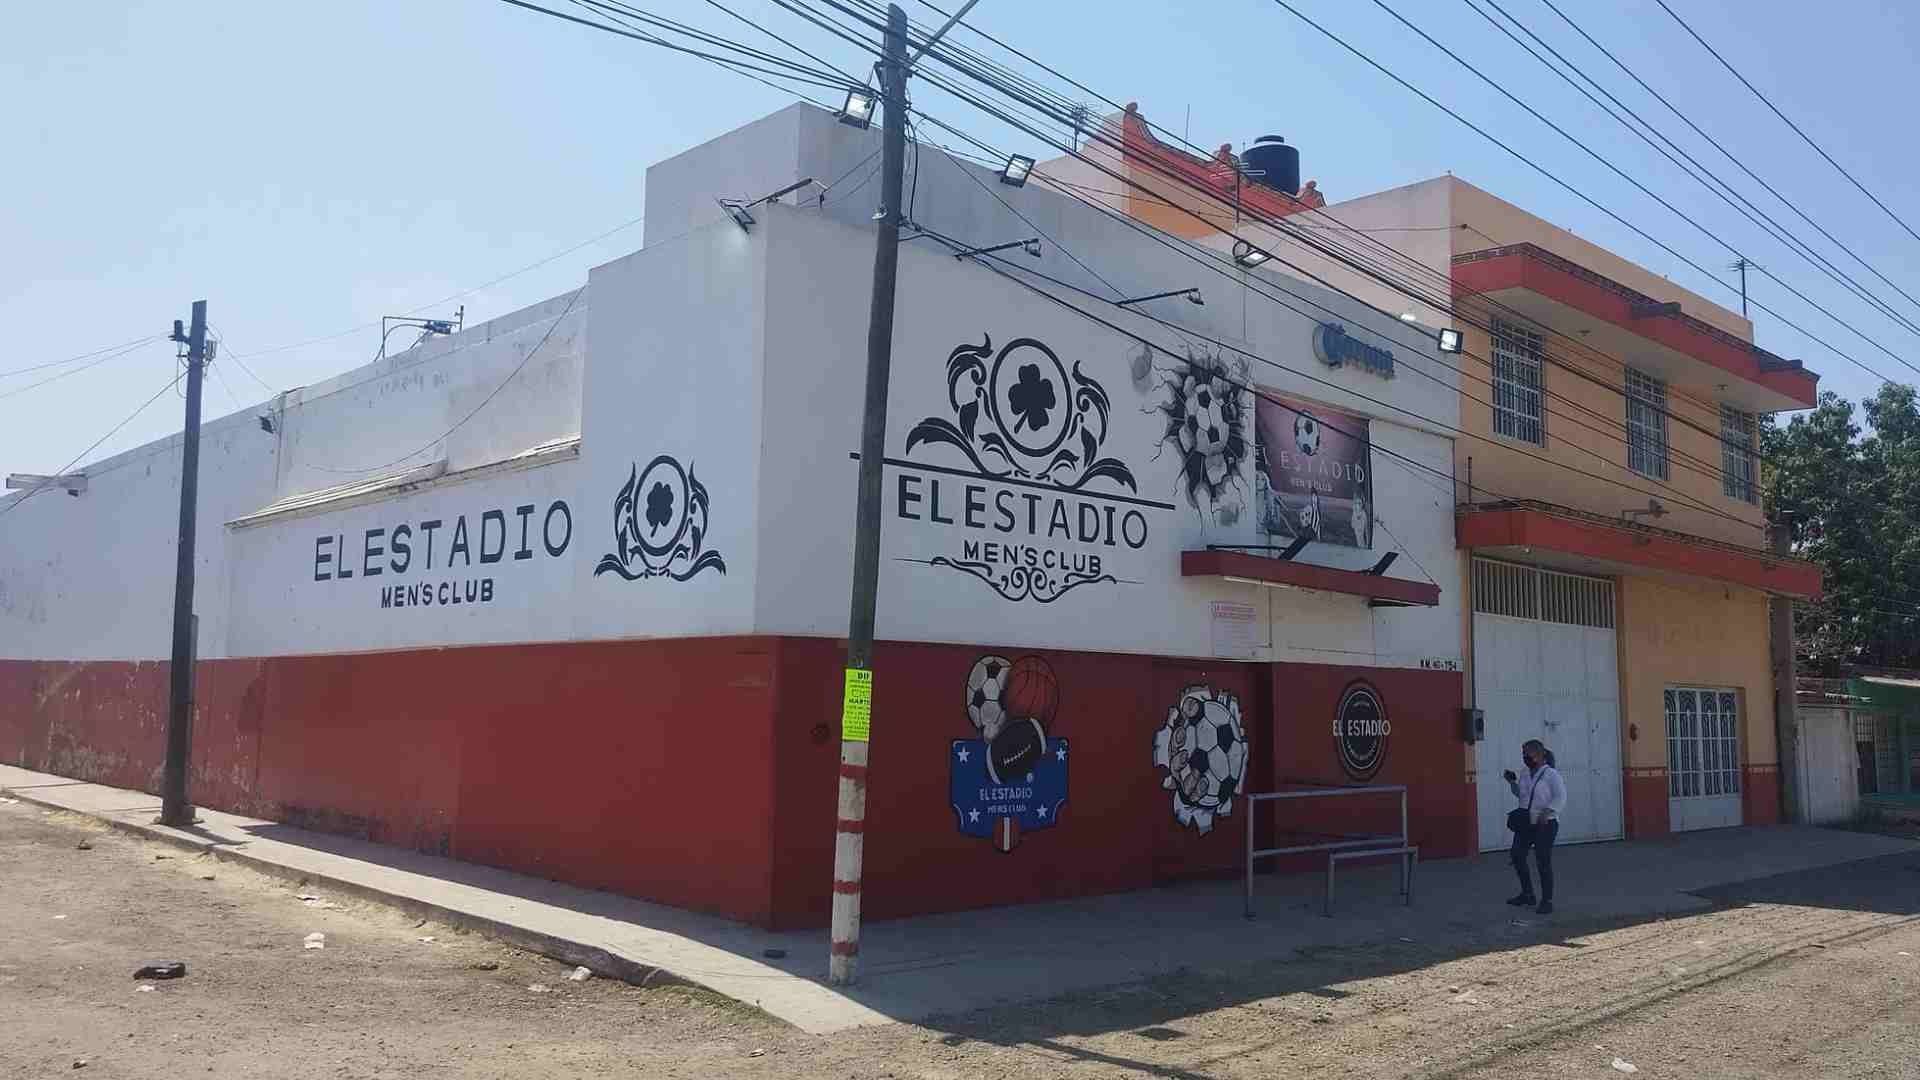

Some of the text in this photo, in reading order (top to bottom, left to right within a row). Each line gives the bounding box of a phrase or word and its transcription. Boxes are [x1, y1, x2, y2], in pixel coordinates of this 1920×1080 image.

[1043, 549, 1102, 575] CLUB
[438, 578, 495, 605] CLUB
[1332, 719, 1392, 737] EL ESTADIO
